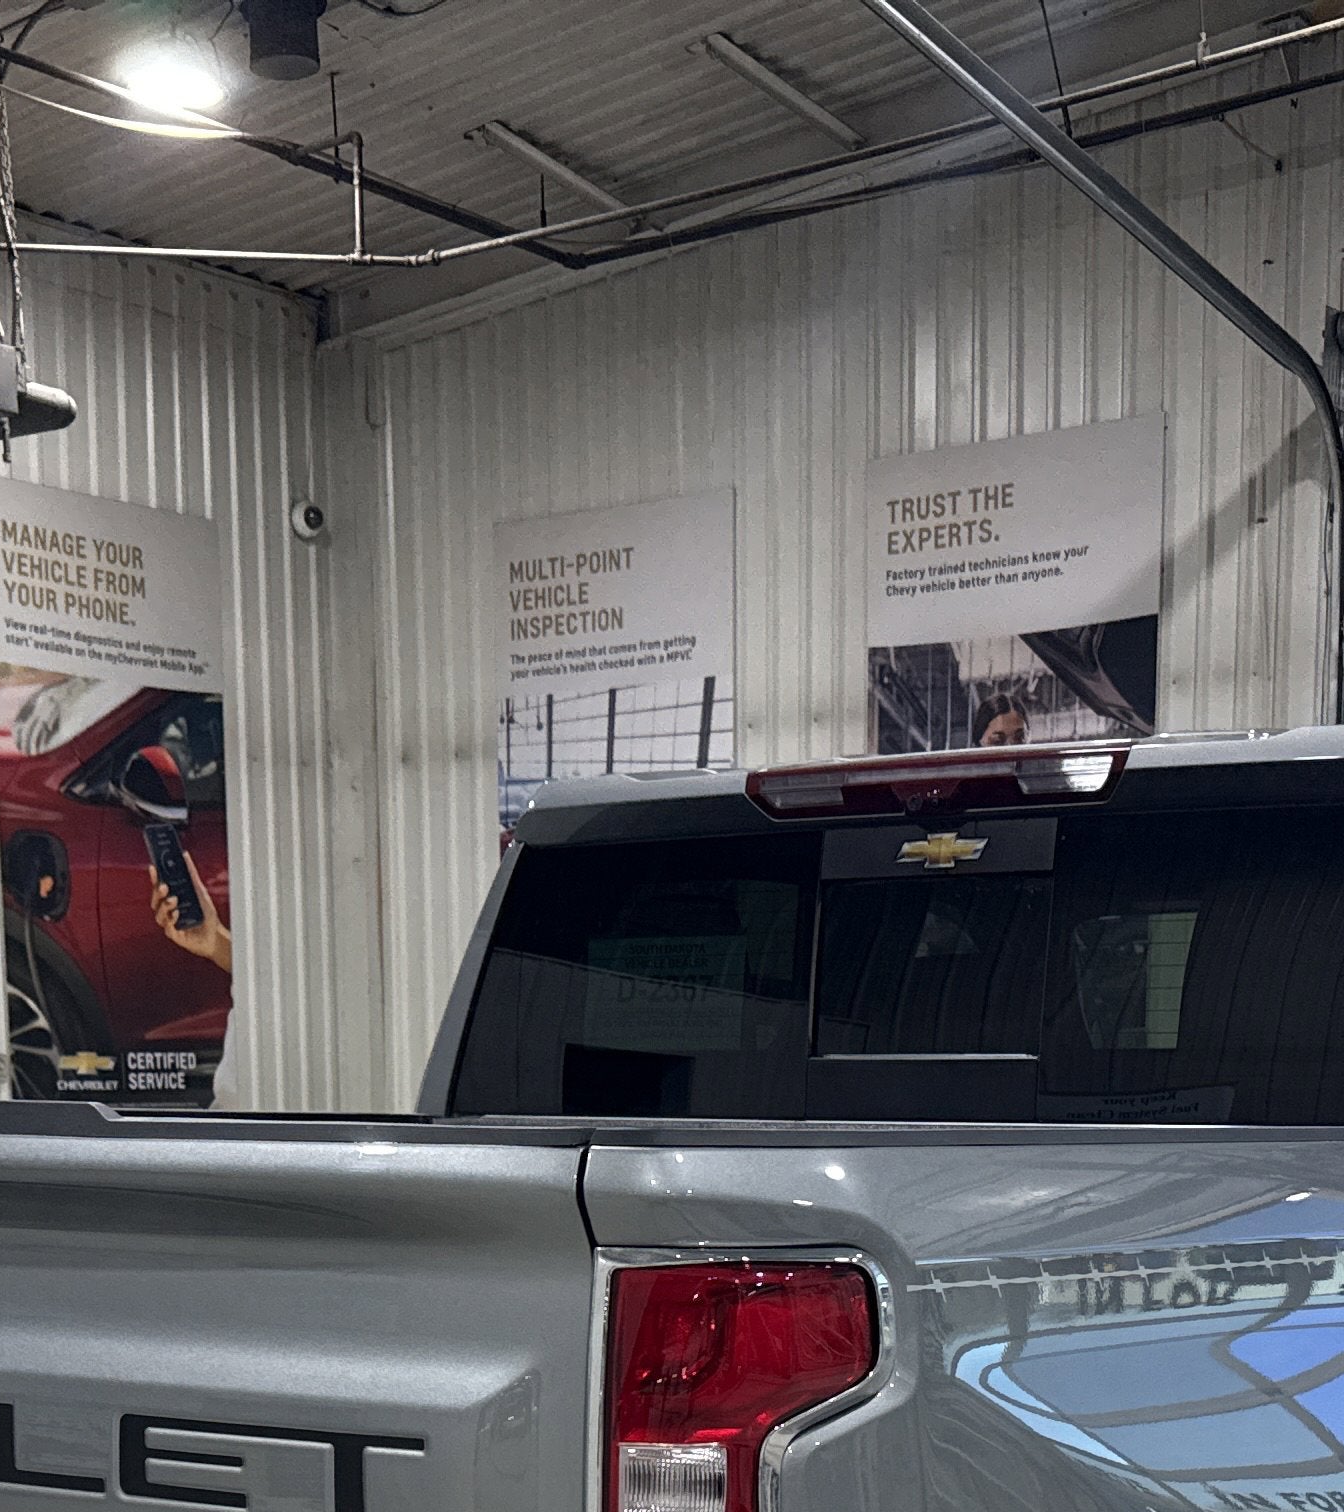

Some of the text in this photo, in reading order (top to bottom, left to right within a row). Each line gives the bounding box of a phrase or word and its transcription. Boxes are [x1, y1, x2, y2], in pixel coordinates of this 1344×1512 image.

[886, 482, 1014, 524] TRUST THE
[0, 518, 143, 569] MANAGE YOUR
[887, 517, 999, 555] EXPERTS.
[1, 549, 145, 599] VEHICLE FROM
[509, 546, 634, 584] MULTI-POINT
[885, 545, 1089, 581] Factory trained technicians know your
[509, 581, 589, 612] VEHICLE
[885, 566, 1064, 597] Chevy vehicle better than anyone.
[3, 578, 136, 626] YOUR PHONE.
[510, 606, 623, 641] INSPECTION
[509, 635, 696, 666] The peace of mind that comes from getting
[127, 1052, 196, 1070] CERTIFIED
[56, 1079, 118, 1090] CHEVROLET
[128, 1072, 185, 1089] SERVICE
